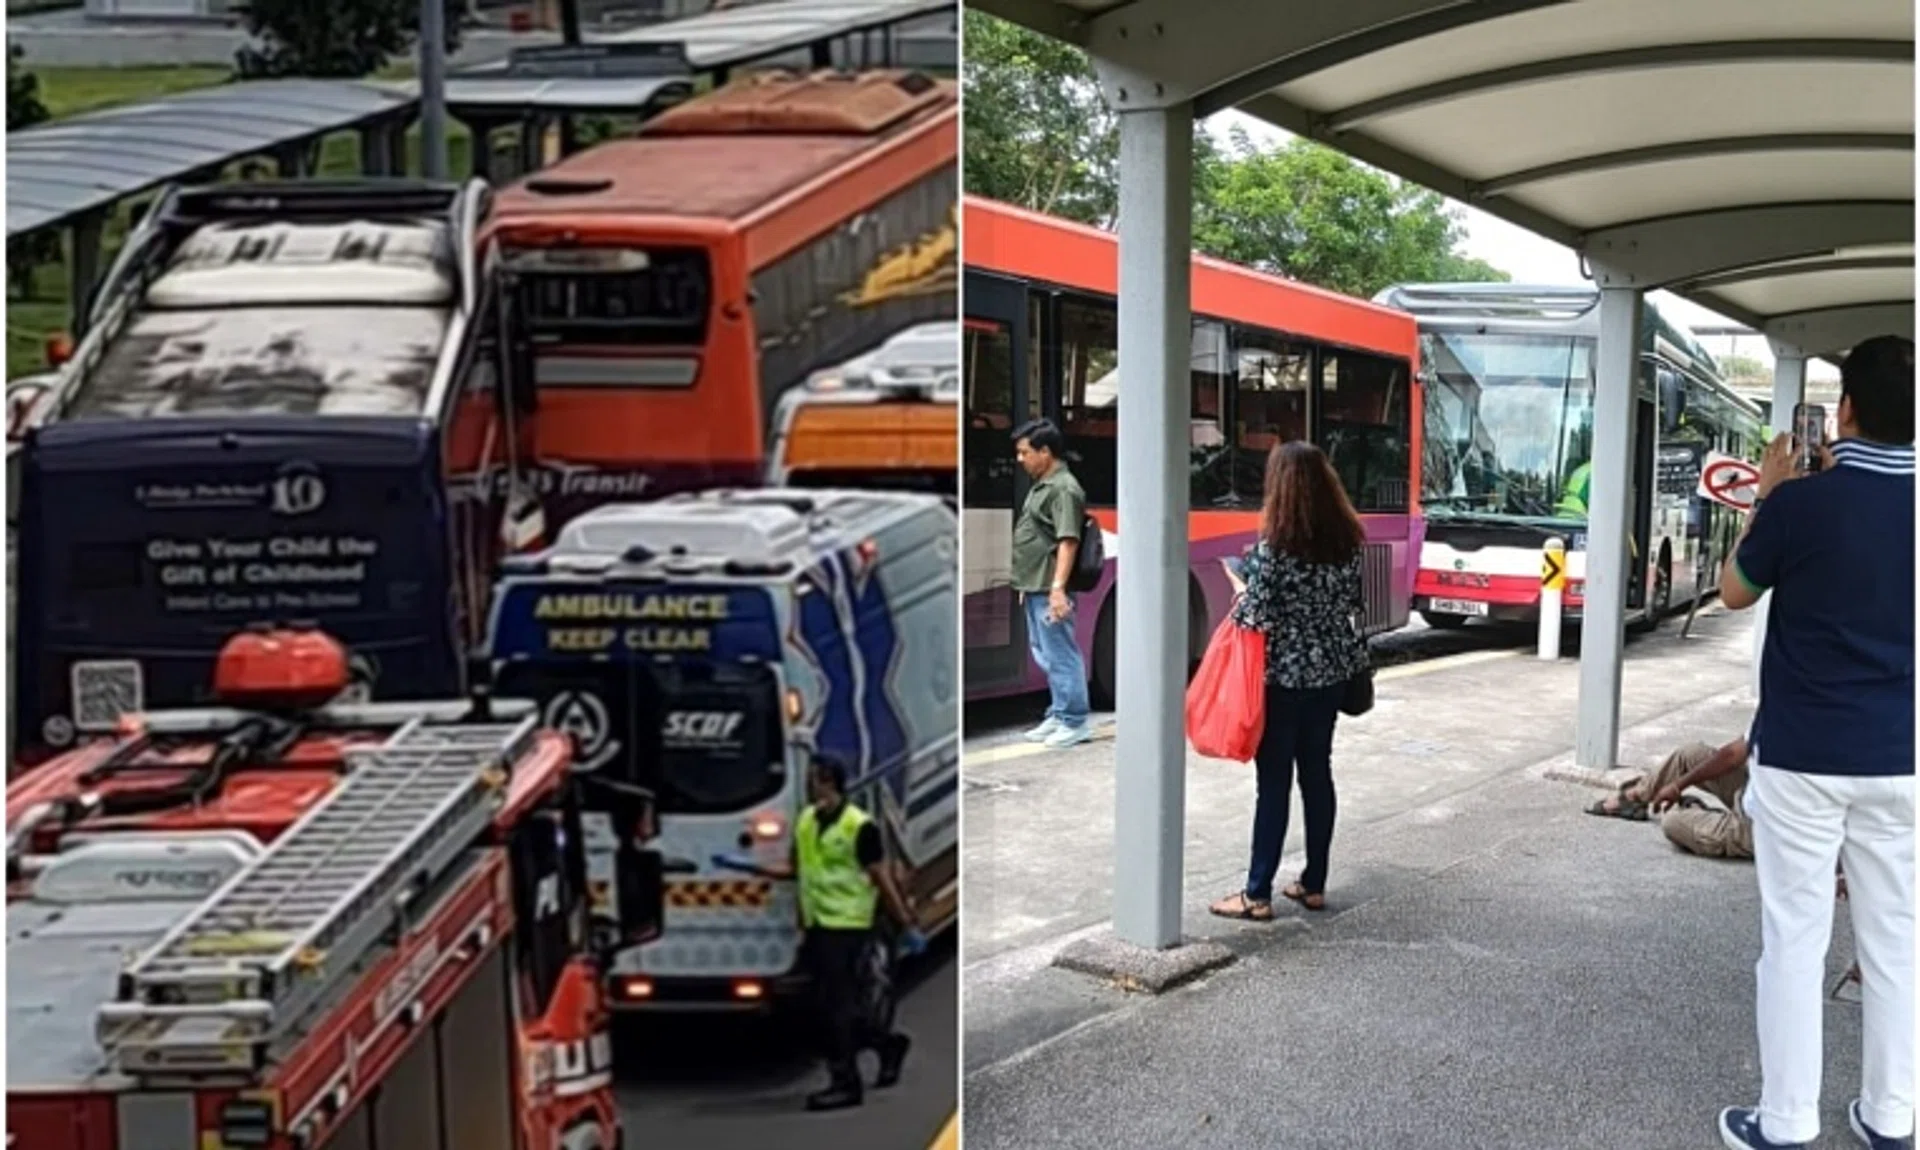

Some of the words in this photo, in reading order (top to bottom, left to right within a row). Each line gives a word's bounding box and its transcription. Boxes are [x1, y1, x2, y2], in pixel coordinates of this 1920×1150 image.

[561, 466, 651, 495] Transit
[270, 475, 326, 514] 10
[147, 540, 202, 560] Give
[207, 539, 262, 558] Your
[268, 537, 331, 557] Child
[337, 537, 378, 555] the
[161, 564, 206, 585] Gift
[212, 564, 237, 583] of
[243, 562, 365, 583] Childhood
[214, 594, 252, 609] Care
[257, 594, 272, 608] to
[535, 594, 730, 620] AMBULANCE
[548, 628, 617, 650] KEEP
[624, 627, 711, 650] CLEAR
[661, 710, 744, 739] SCDF
